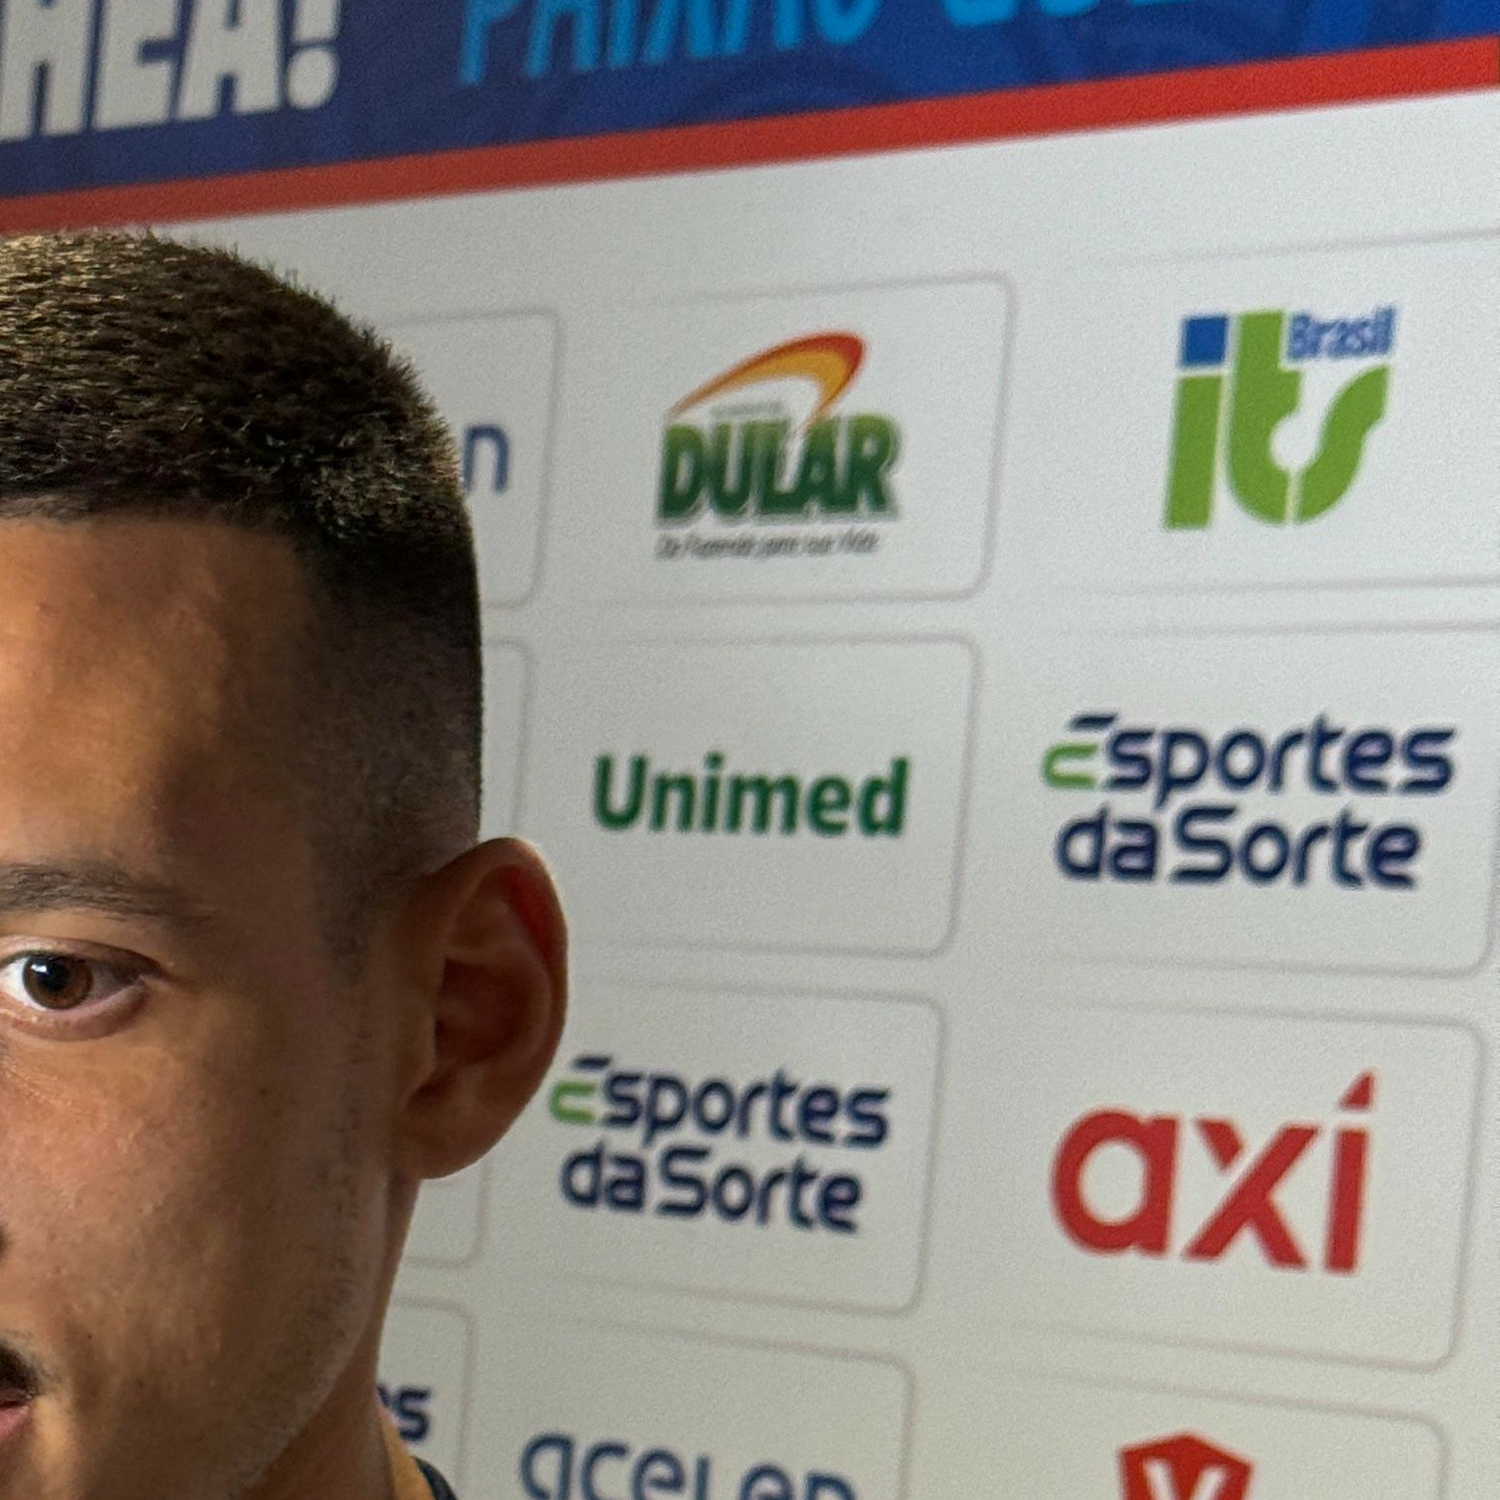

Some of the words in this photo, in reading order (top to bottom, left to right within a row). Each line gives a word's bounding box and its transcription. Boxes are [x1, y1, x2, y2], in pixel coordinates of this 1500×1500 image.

[1289, 305, 1396, 362] Brasil
[657, 413, 900, 524] DULAR
[592, 752, 910, 836] Unimed
[1041, 713, 1457, 806] Esportes
[549, 1055, 891, 1148] Esportes
